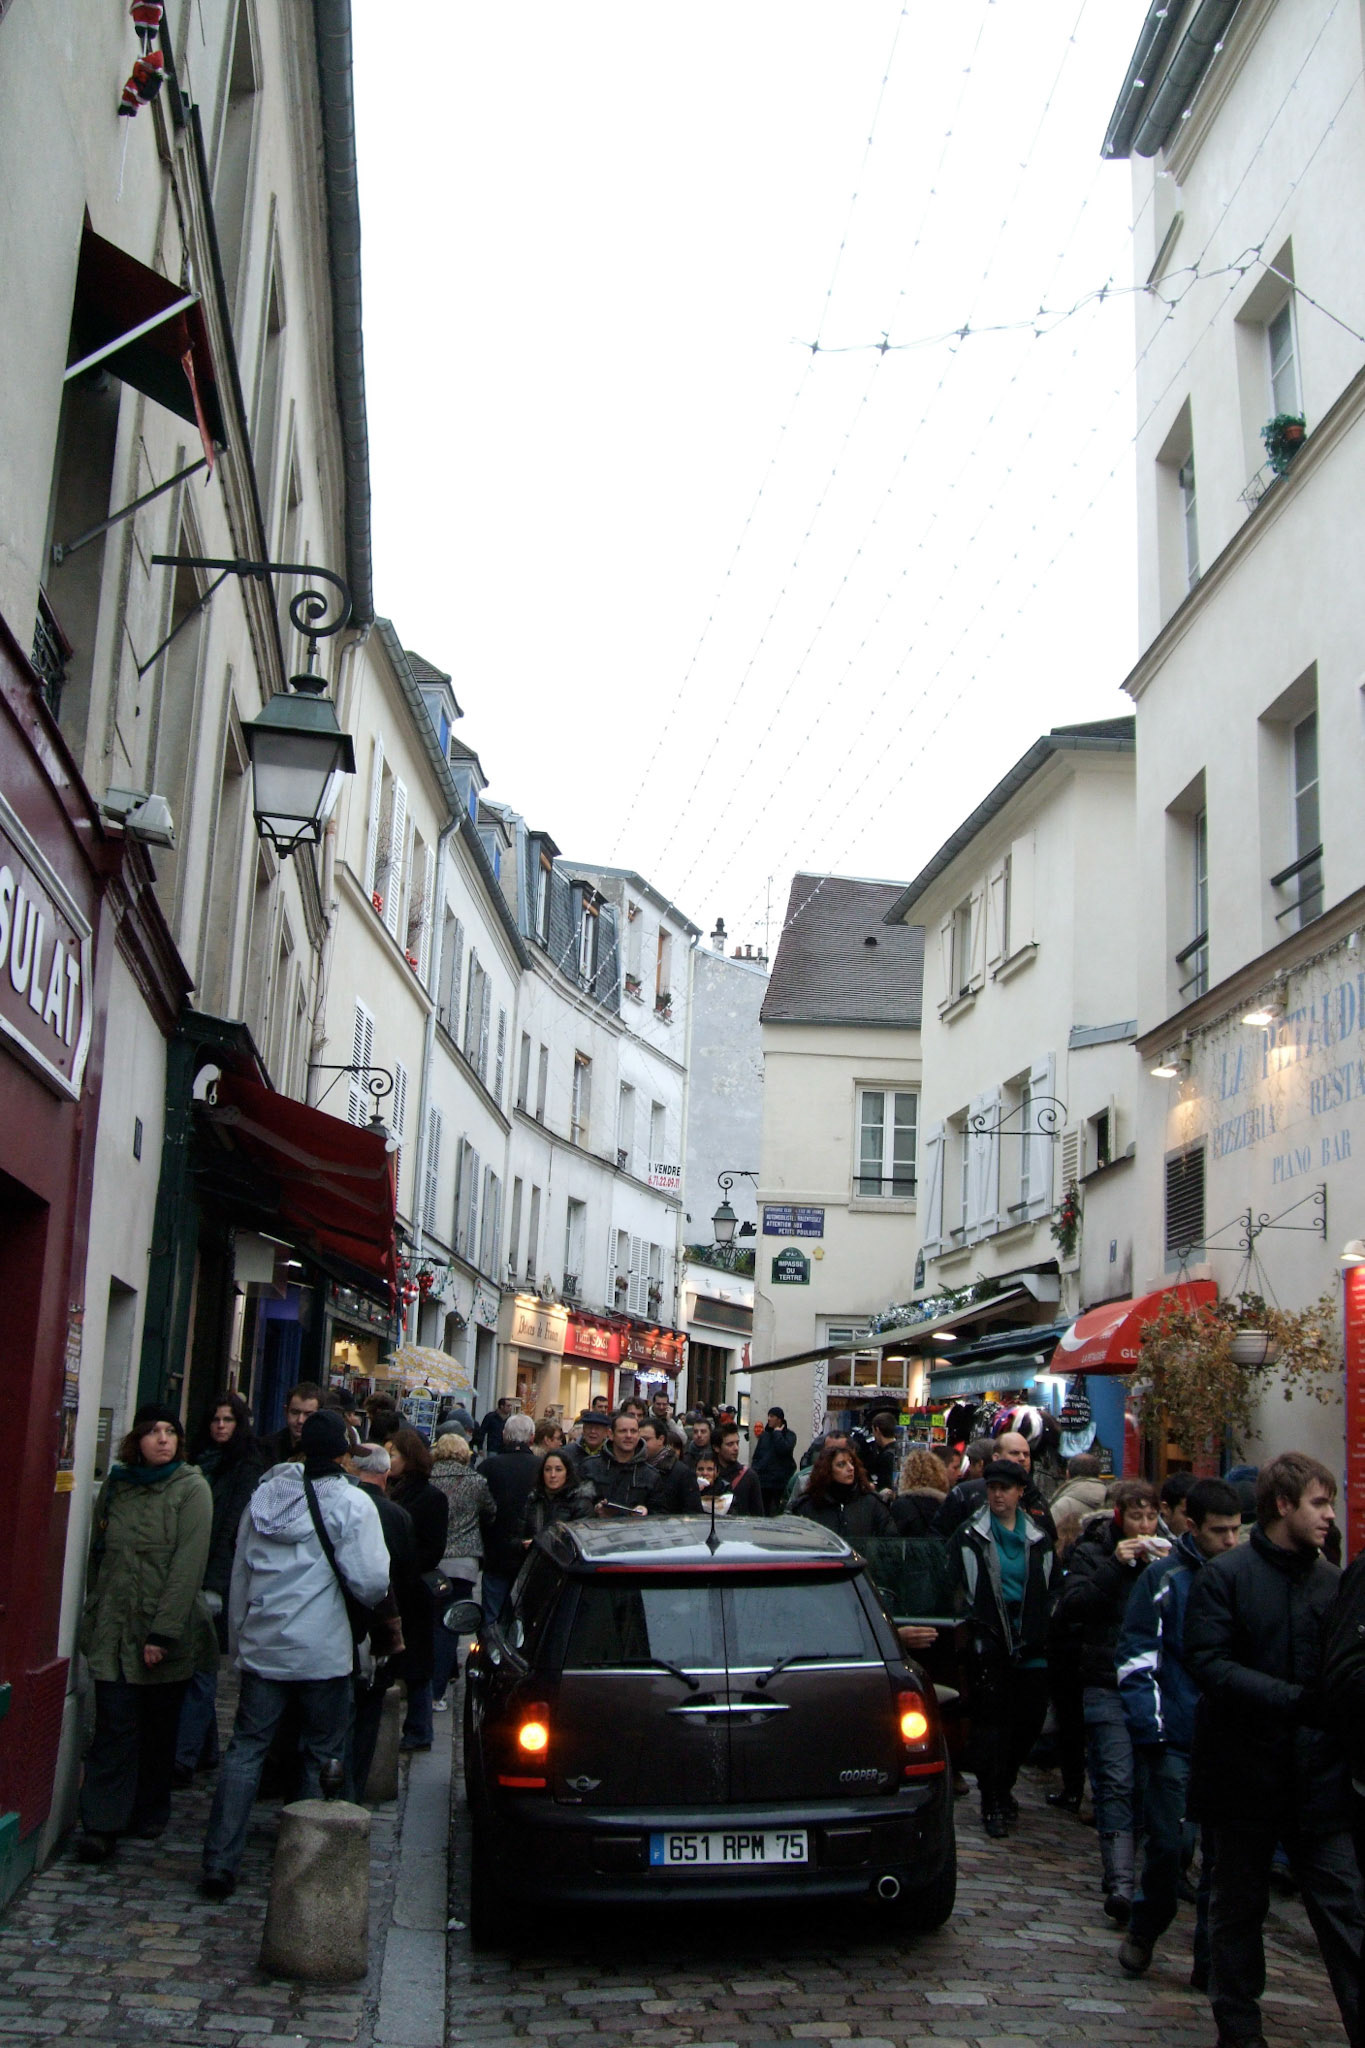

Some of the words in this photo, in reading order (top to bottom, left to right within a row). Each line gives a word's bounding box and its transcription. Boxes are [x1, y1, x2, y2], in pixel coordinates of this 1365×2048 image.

[1212, 1103, 1276, 1160] PIZZERIA
[654, 1164, 681, 1176] VENDRE
[1272, 1145, 1311, 1185] PIANO
[1322, 1129, 1352, 1168] BAR
[840, 1769, 877, 1781] COOPER
[670, 1836, 710, 1861] 651
[723, 1835, 765, 1860] RPM
[776, 1834, 804, 1859] 75
